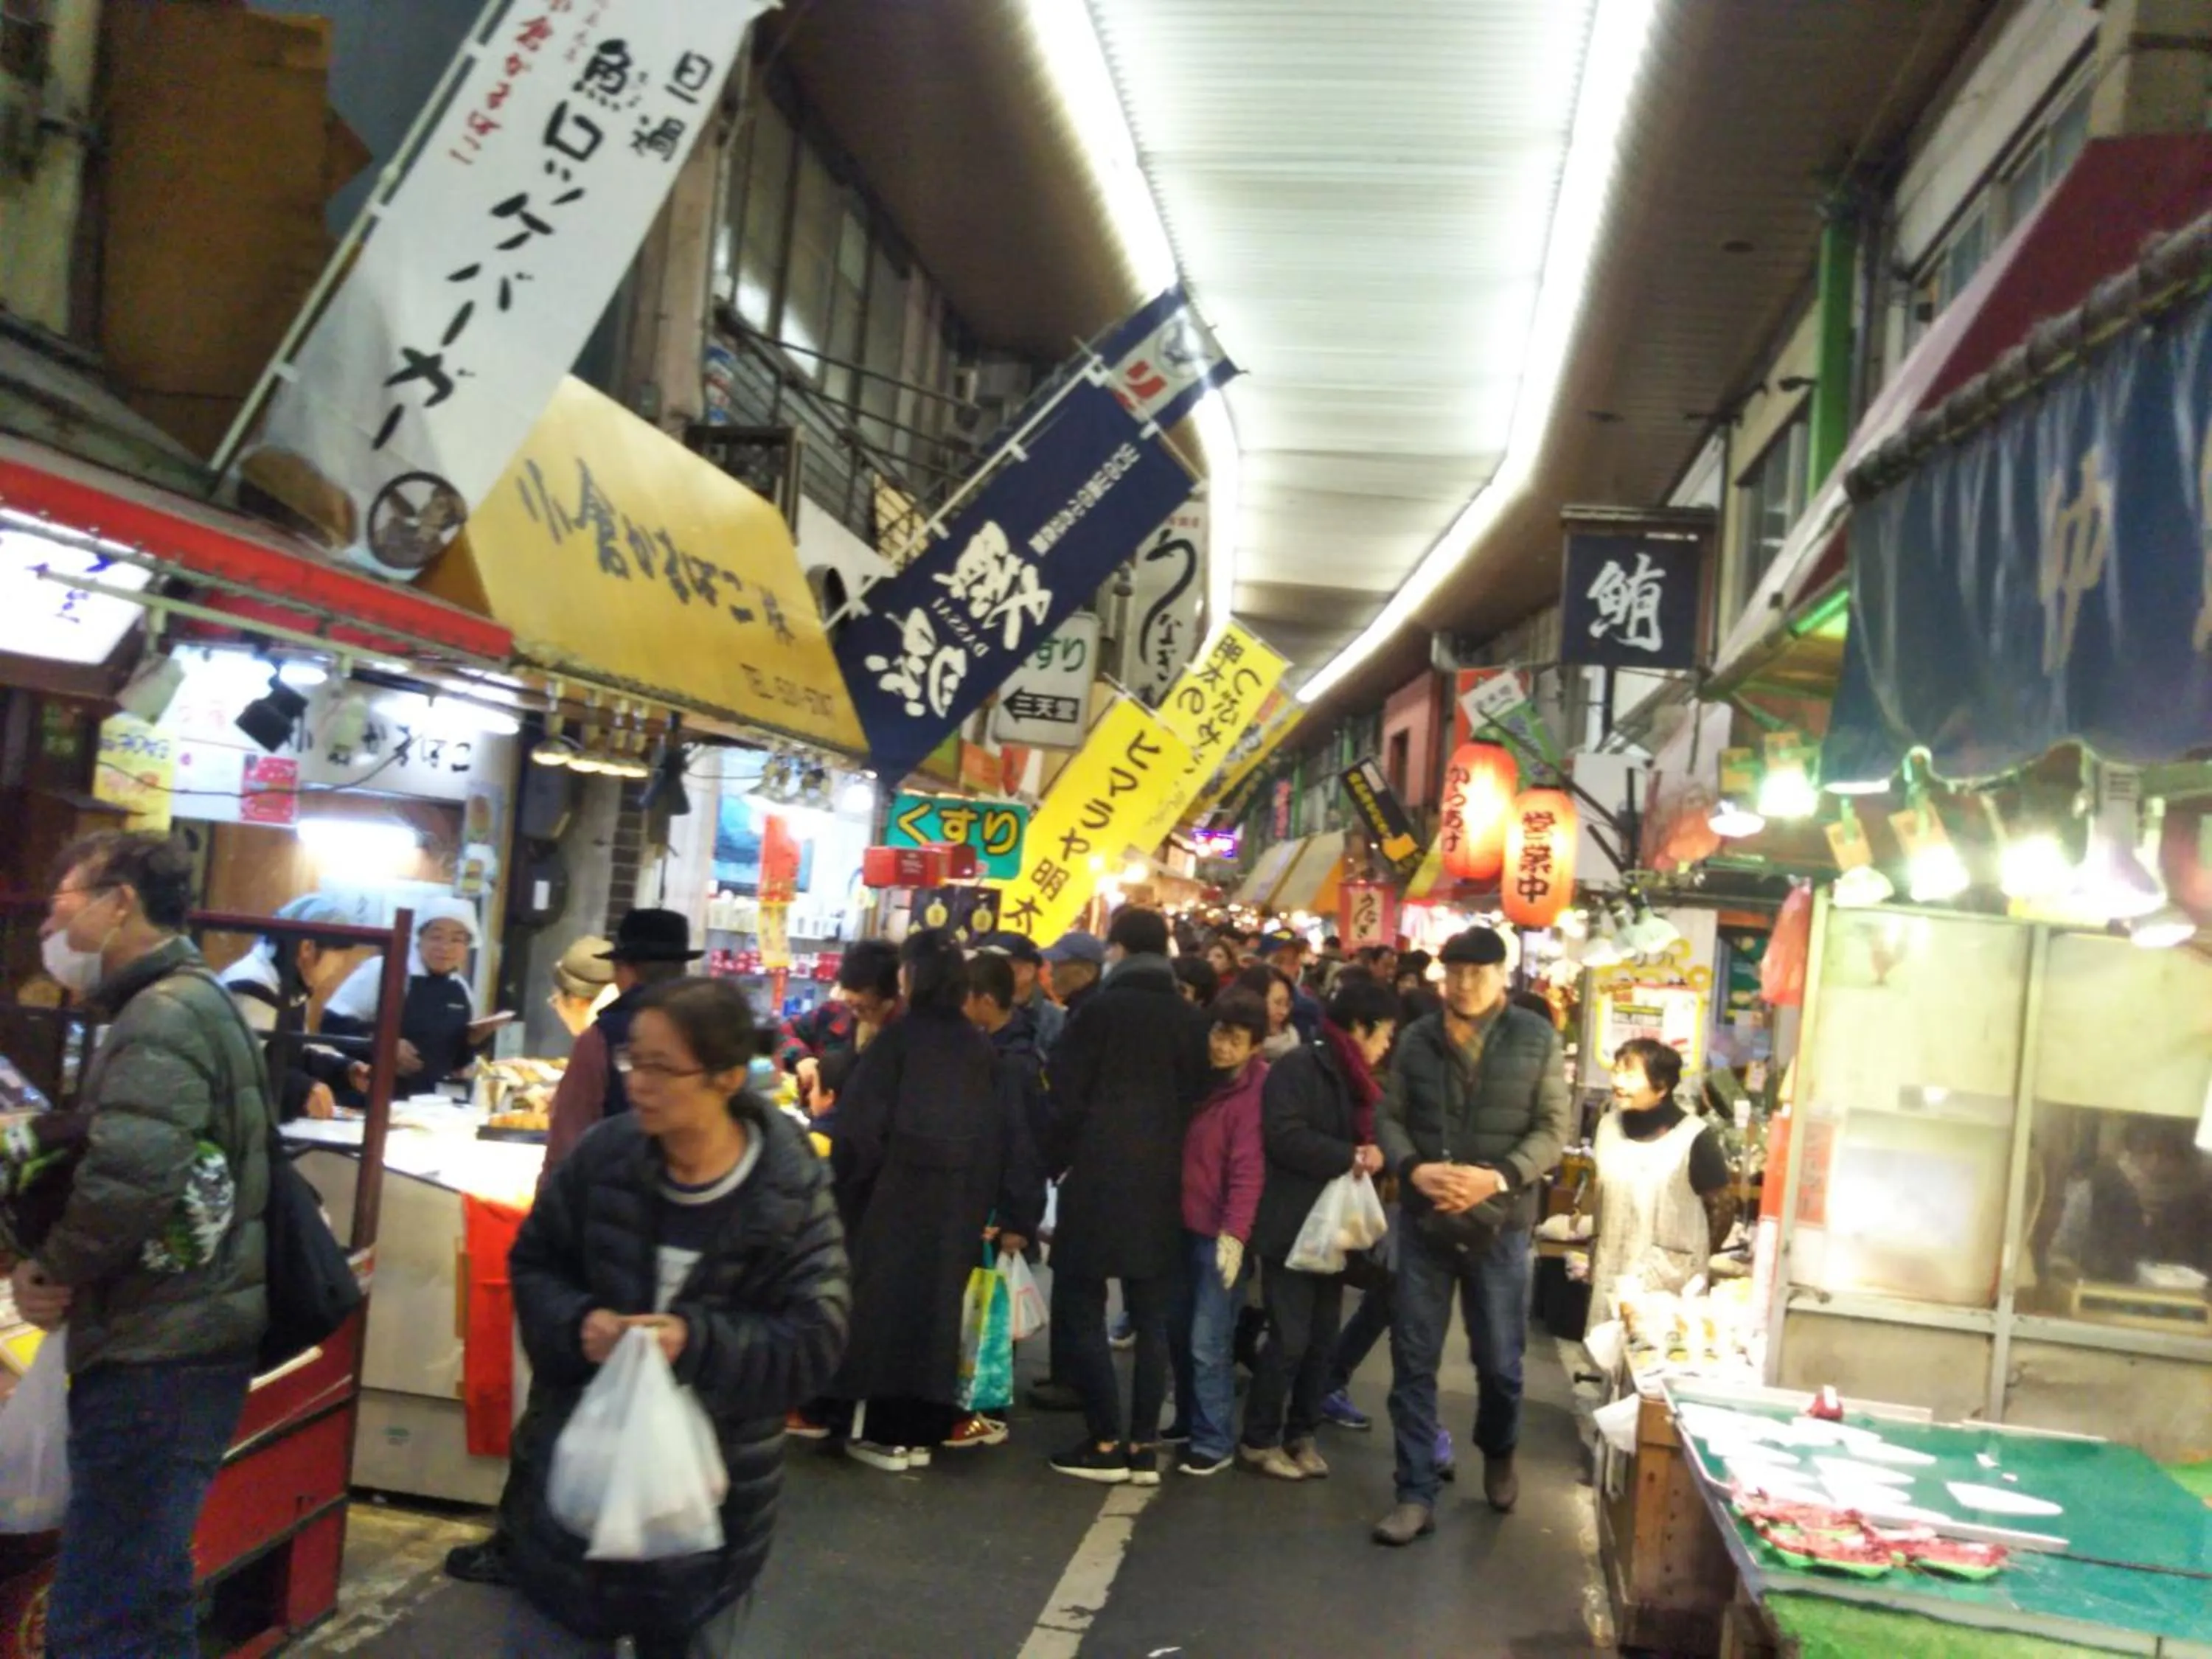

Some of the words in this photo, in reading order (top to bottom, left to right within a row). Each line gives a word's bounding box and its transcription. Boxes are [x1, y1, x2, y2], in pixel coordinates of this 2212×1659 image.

[628, 49, 714, 162] 旦過
[1587, 554, 1666, 652] 鮪
[1023, 636, 1087, 673] すり
[1014, 695, 1078, 720] 三天堂
[897, 803, 1020, 855] くすり
[1516, 811, 1555, 904] 営業中
